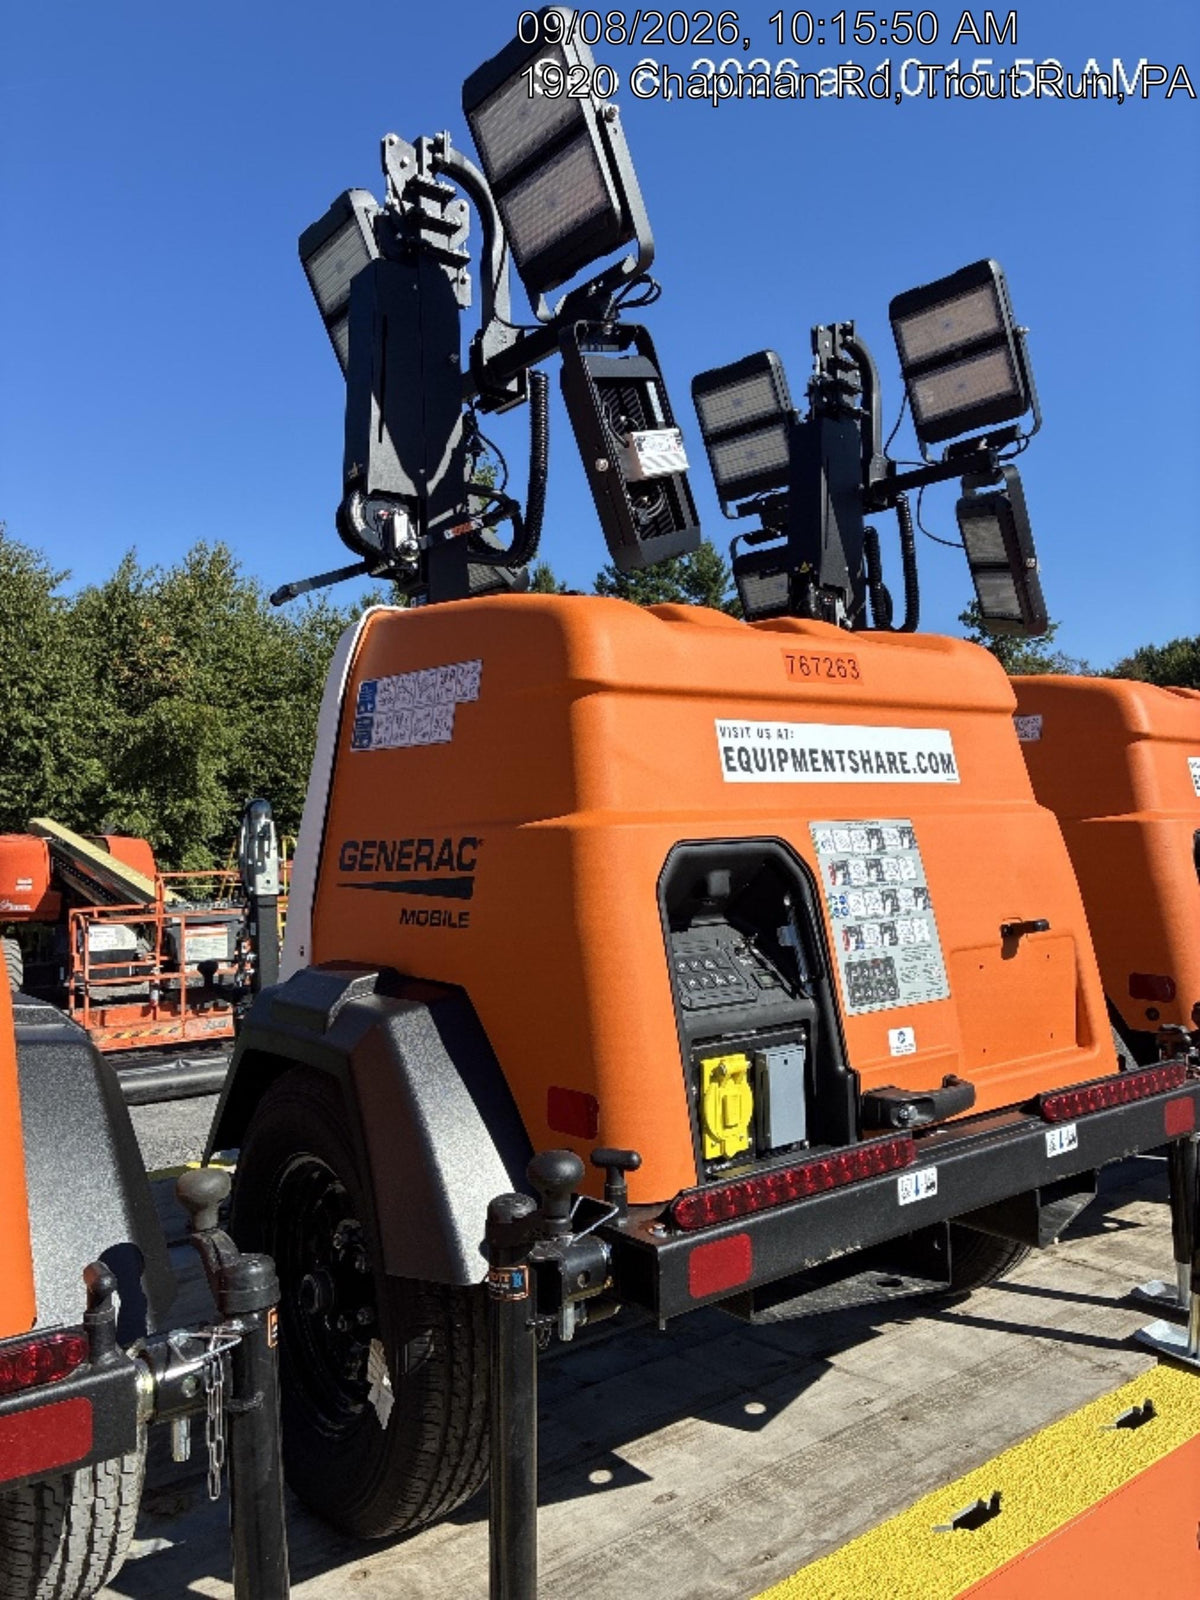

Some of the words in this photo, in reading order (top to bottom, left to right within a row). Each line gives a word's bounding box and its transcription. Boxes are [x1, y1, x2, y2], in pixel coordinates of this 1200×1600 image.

[785, 655, 861, 680] 767263
[719, 726, 751, 739] VISIT
[757, 728, 771, 740] US
[777, 729, 794, 740] AT:
[723, 746, 956, 774] EQUIPMENTSHARE.COM
[339, 837, 477, 872] GENERAC
[399, 908, 470, 928] MOBILE
